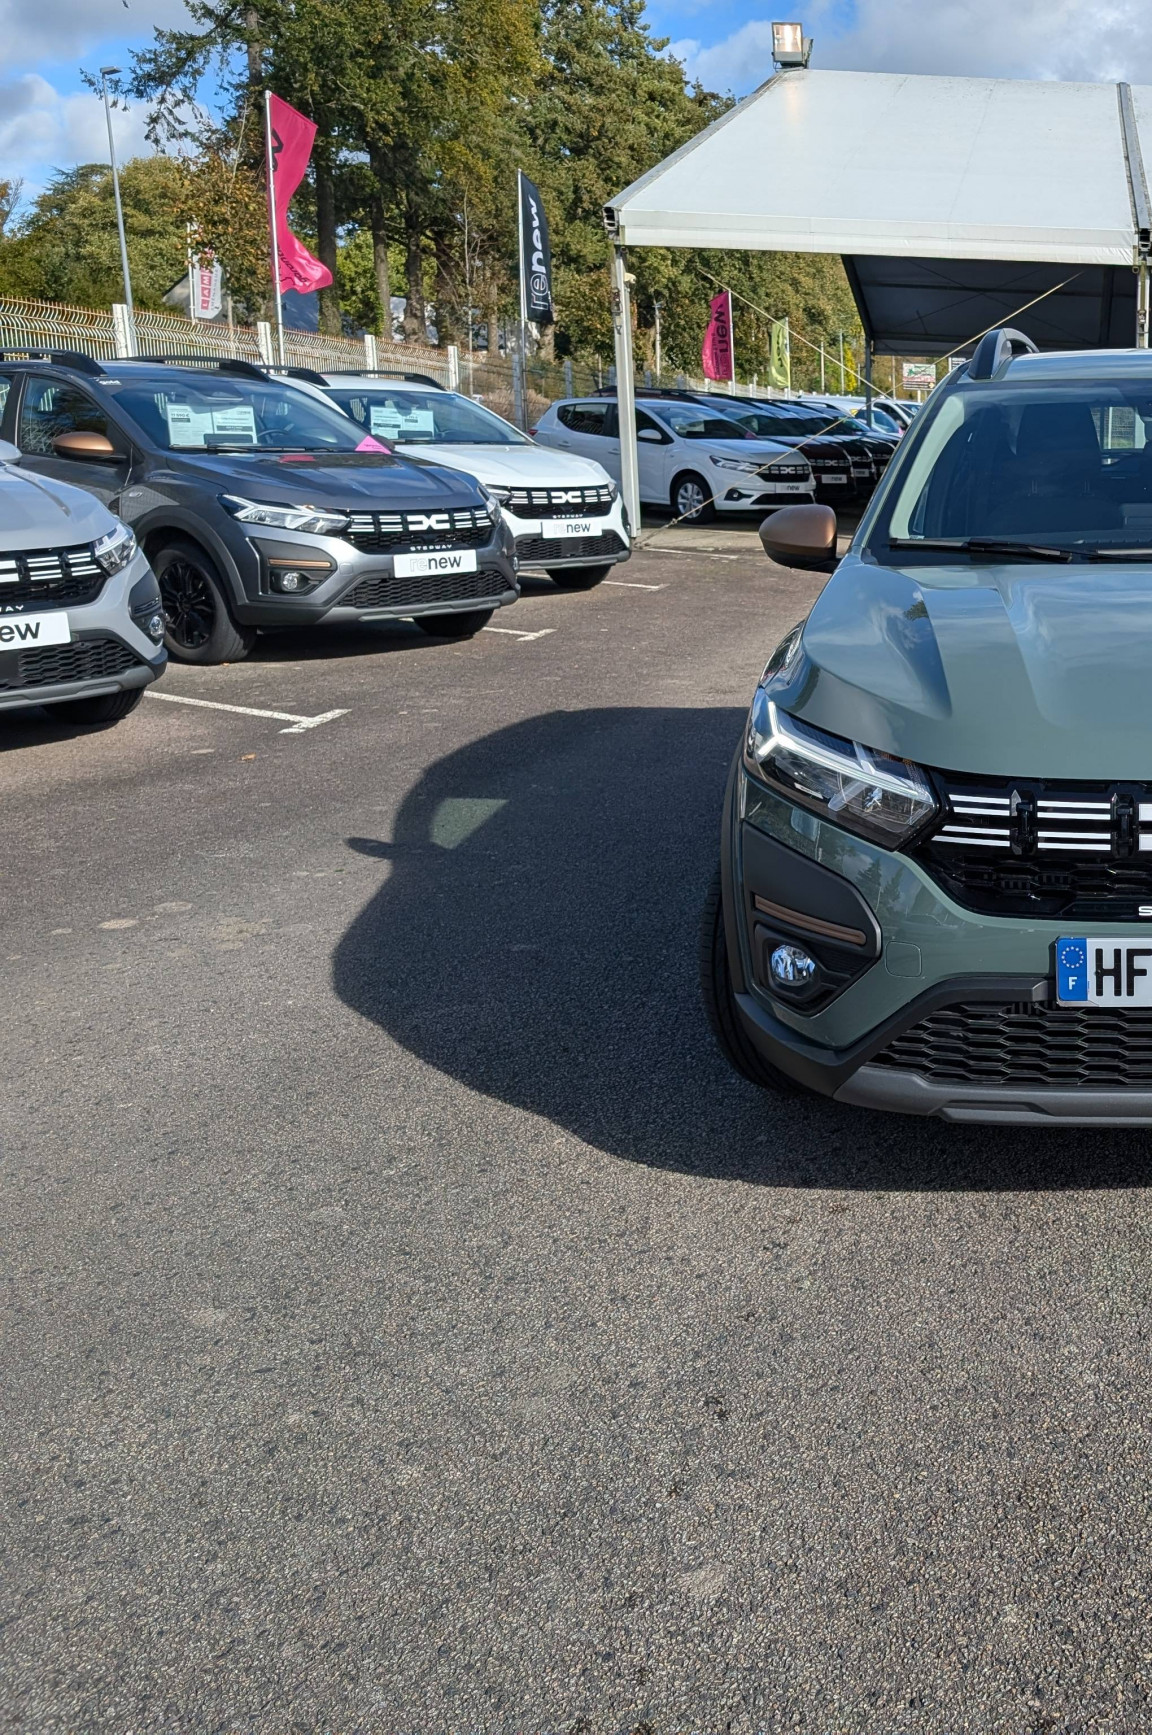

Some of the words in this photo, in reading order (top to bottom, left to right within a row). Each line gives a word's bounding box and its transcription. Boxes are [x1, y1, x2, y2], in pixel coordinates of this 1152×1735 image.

[528, 194, 548, 310] renew
[410, 556, 461, 572] renew
[1068, 977, 1077, 990] F
